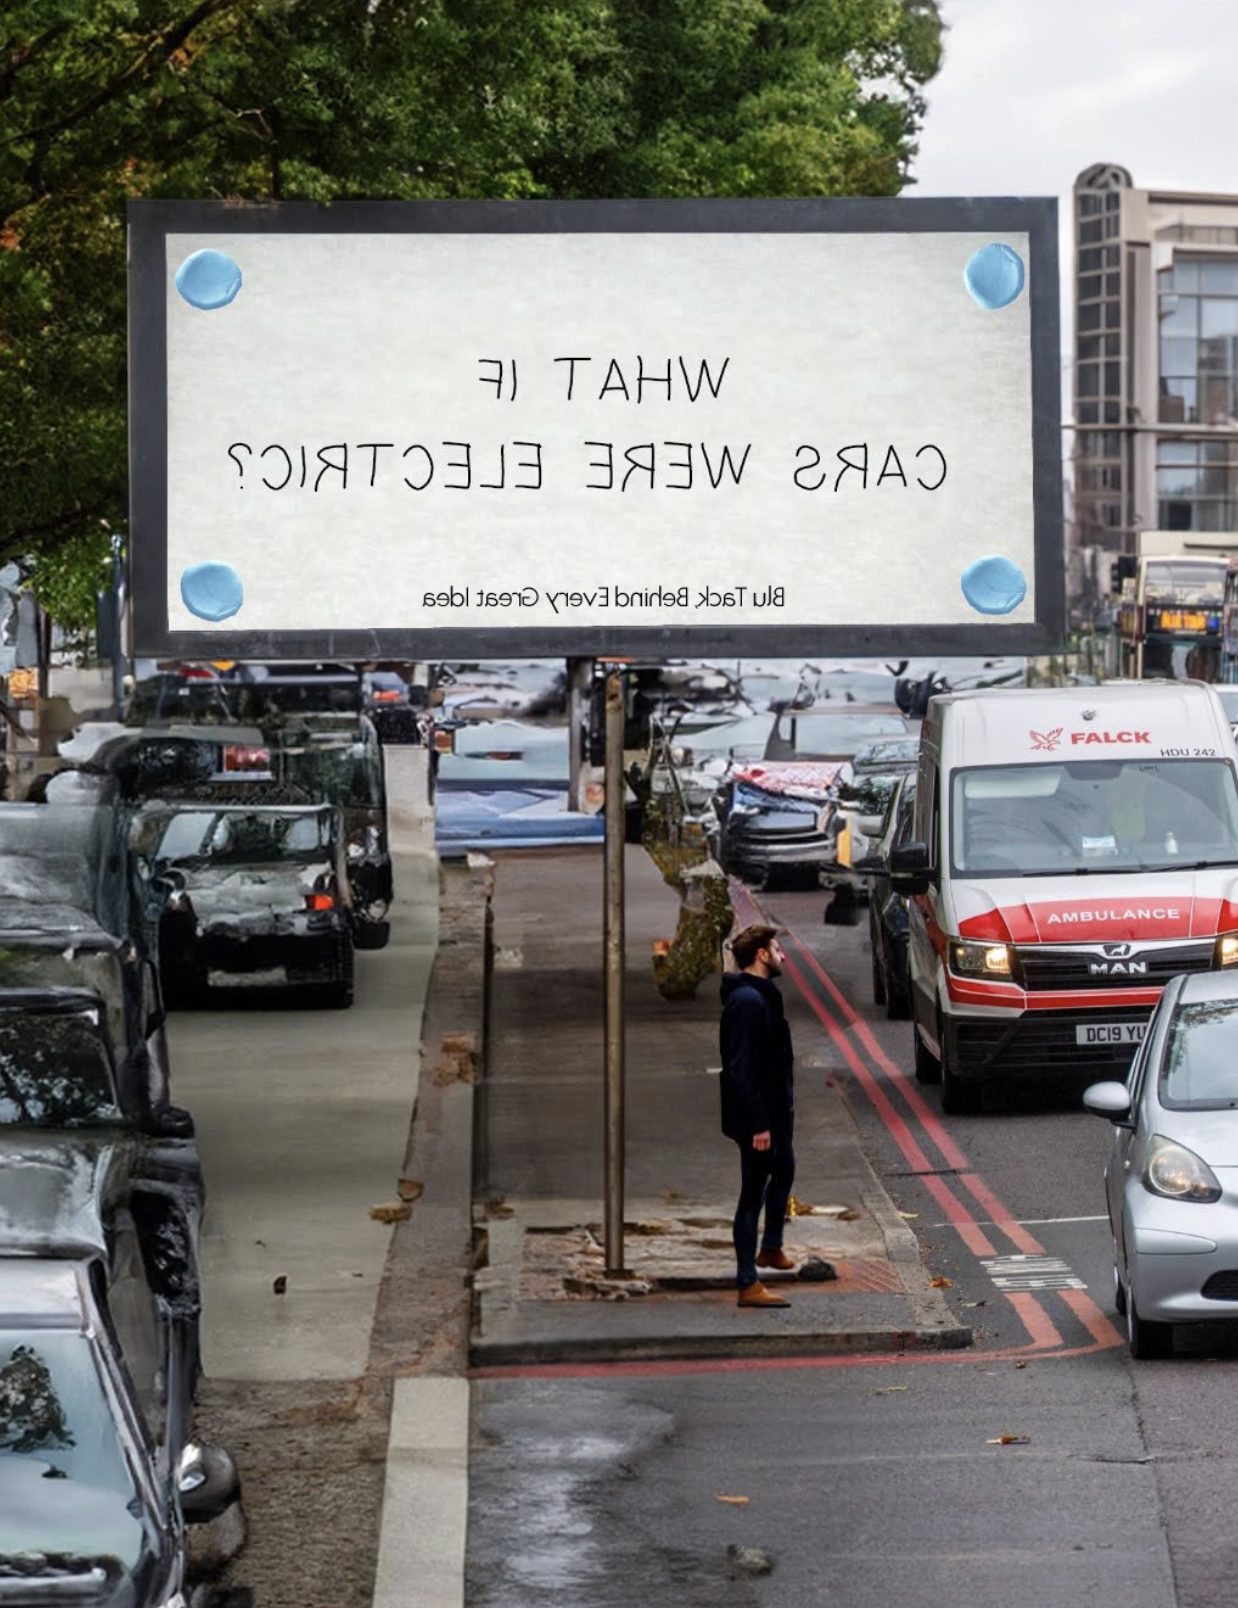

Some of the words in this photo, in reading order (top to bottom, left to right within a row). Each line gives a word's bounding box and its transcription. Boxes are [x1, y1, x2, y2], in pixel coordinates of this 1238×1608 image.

[1070, 732, 1152, 745] FALCK
[1160, 748, 1190, 758] HDU
[1193, 748, 1217, 757] 242
[1047, 909, 1181, 924] AMBULANCE
[1090, 961, 1146, 975] MAN
[1086, 1026, 1122, 1042] DC19
